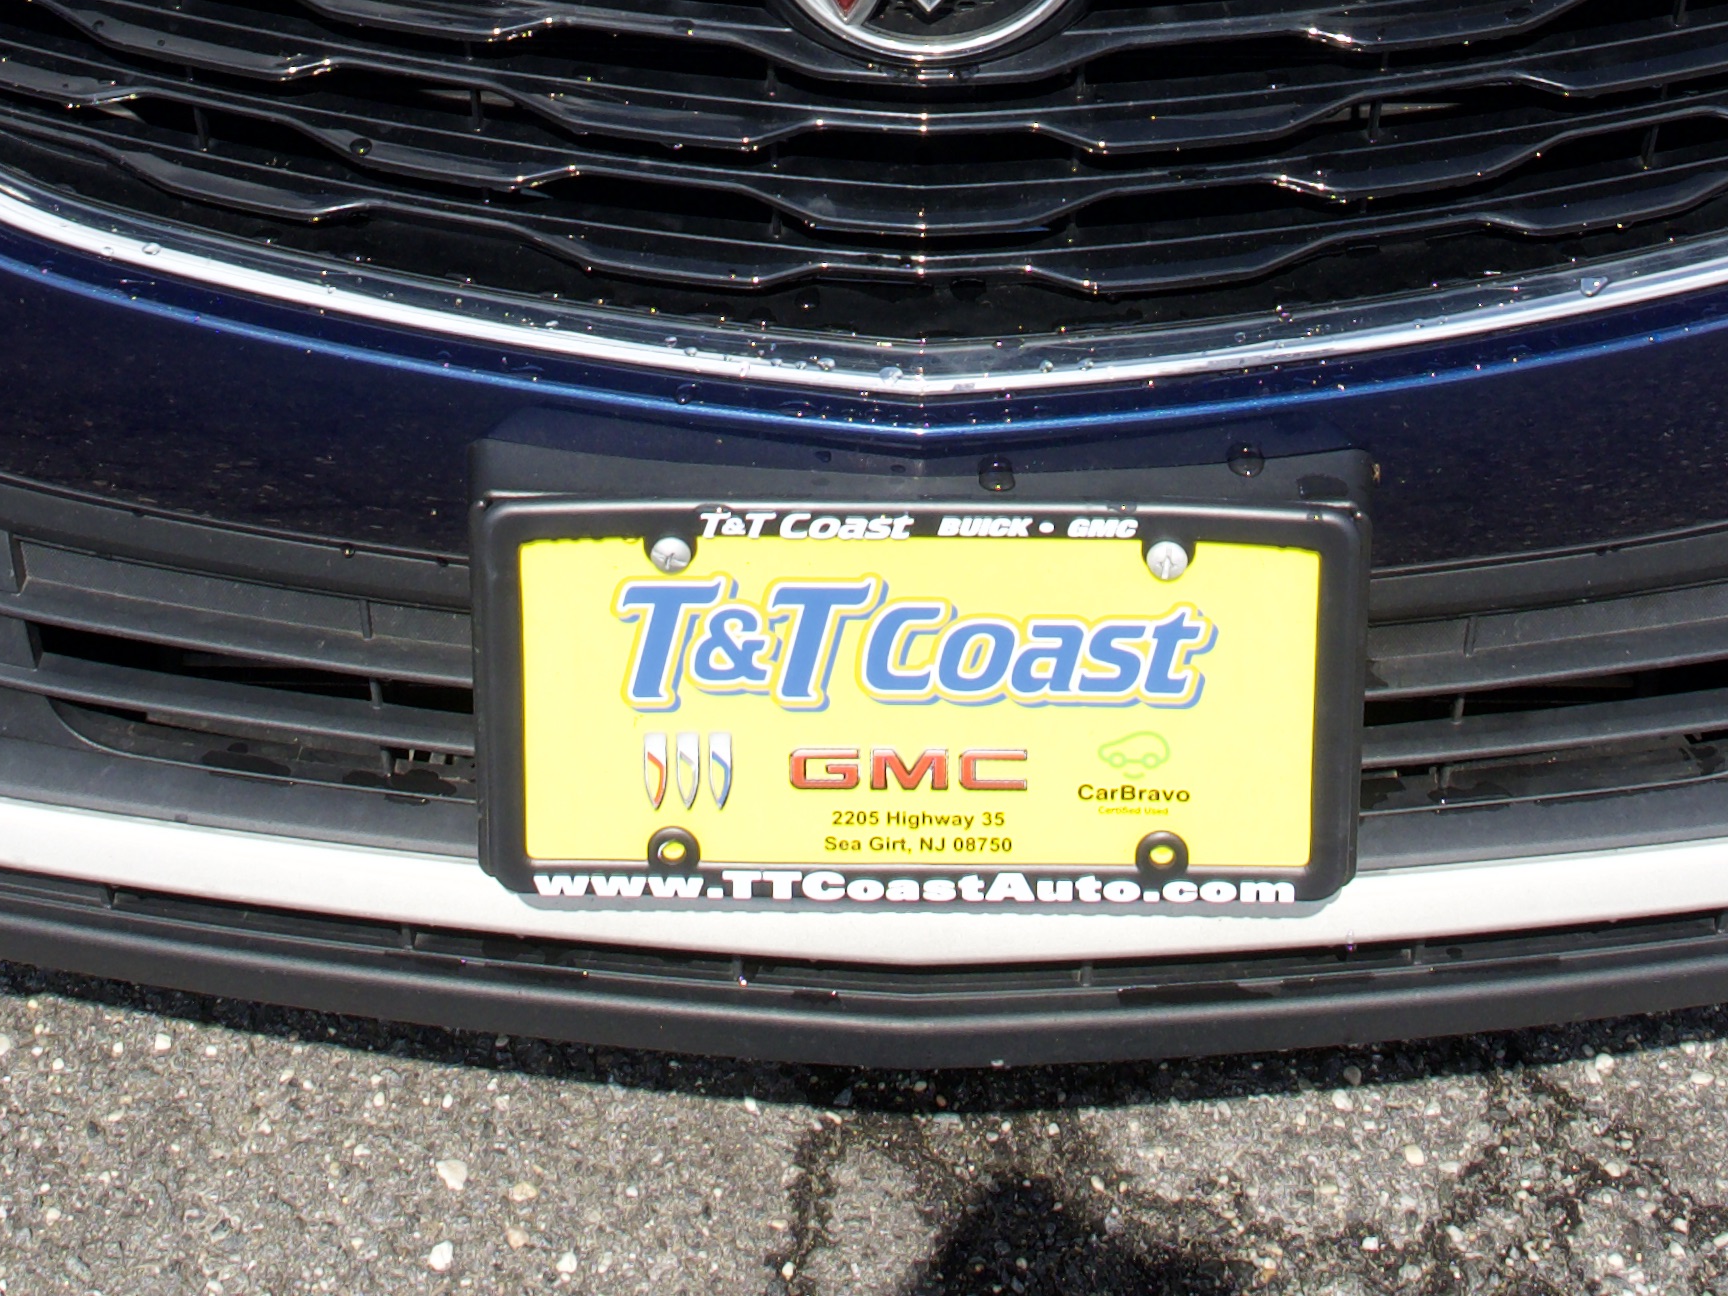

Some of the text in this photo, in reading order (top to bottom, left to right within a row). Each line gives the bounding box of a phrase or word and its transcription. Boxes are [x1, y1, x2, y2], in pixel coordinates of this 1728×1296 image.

[700, 511, 915, 541] T&T Coast
[937, 516, 1139, 539] BUICK GMC
[615, 575, 1216, 711] T&T Coast
[788, 747, 1029, 791] GMC
[1077, 783, 1191, 803] CarBravo
[831, 810, 1006, 830] 2205 Highway 35
[824, 835, 1013, 855] Sea Girt, NJ 08750
[534, 870, 1296, 904] www.TTCoastAuto.com
